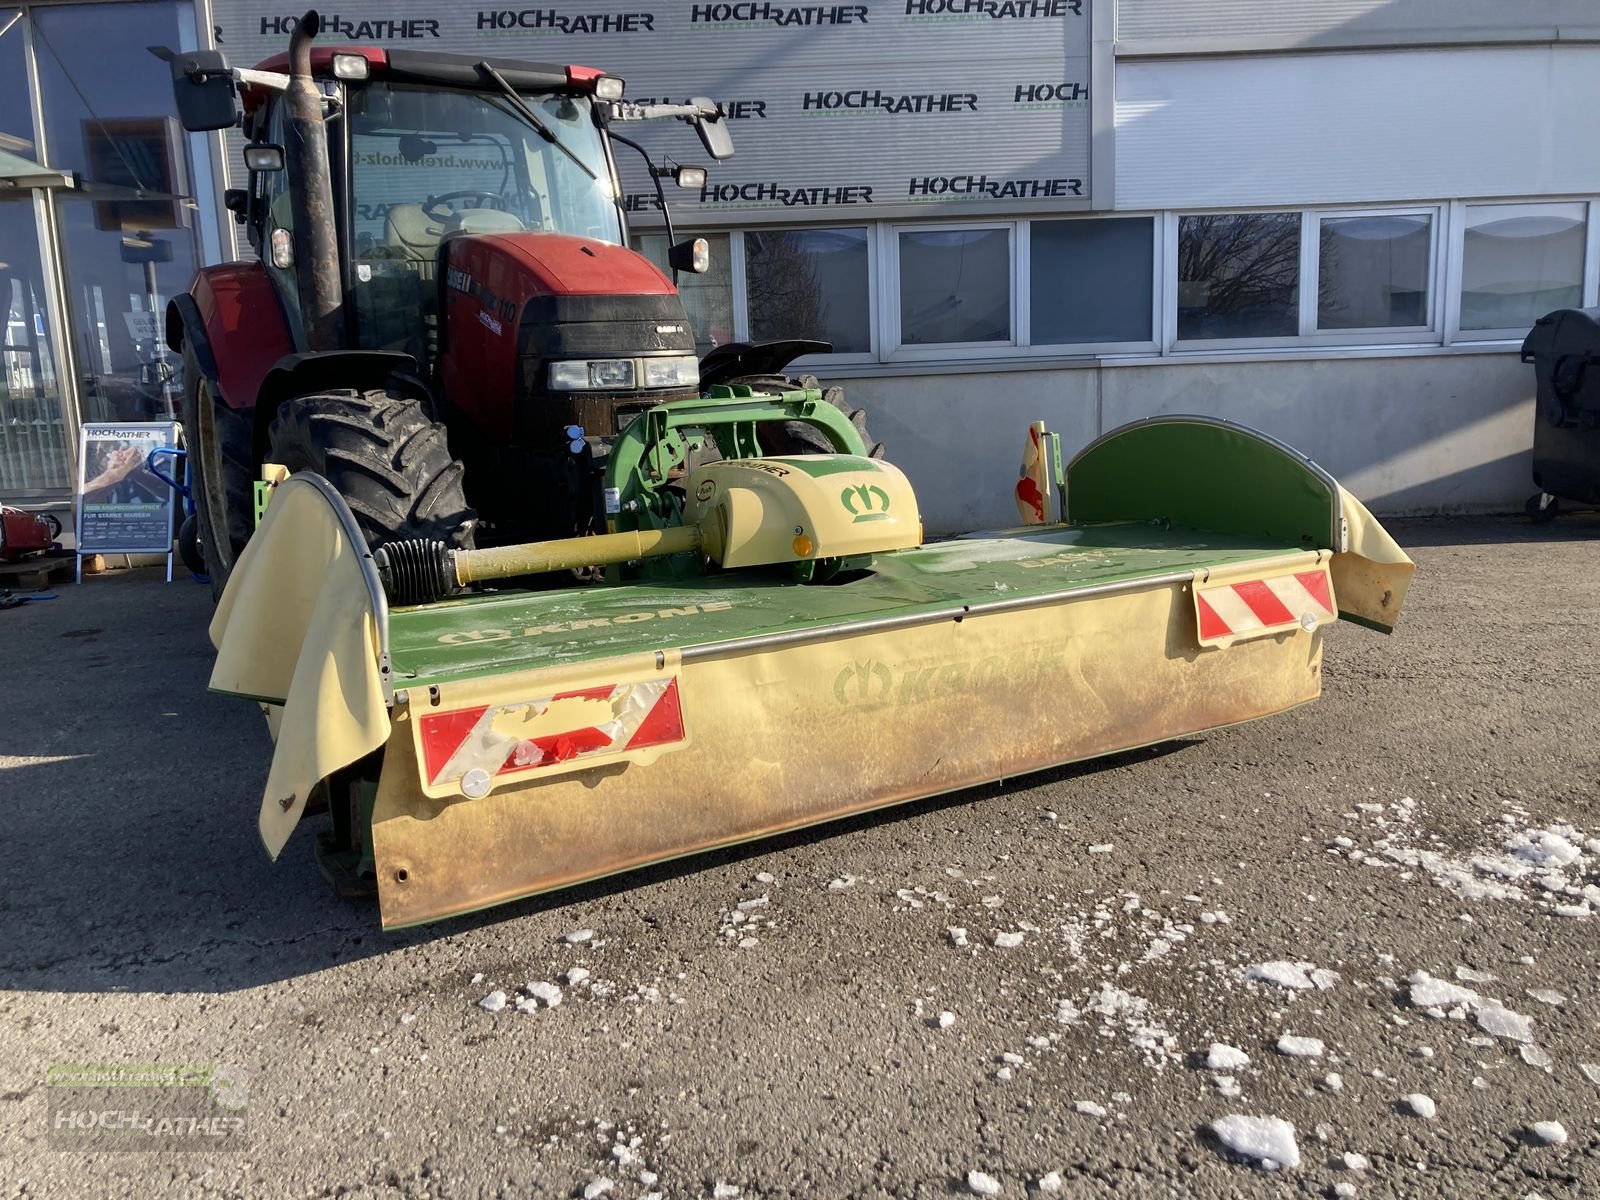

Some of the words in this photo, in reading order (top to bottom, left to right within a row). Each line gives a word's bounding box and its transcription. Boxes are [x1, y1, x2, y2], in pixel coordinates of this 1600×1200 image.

[477, 9, 655, 34] HOCHRATHER
[691, 2, 869, 26] HOCHRATHER
[905, 0, 1083, 19] HOCHRATHER
[260, 15, 440, 39] HOHRATHER
[802, 90, 978, 113] HOCHRATHER
[700, 183, 873, 206] HOCHRATHER
[909, 175, 1082, 199] HOCHRATHER
[88, 430, 150, 438] HOCHRATHER
[524, 601, 732, 637] KRONE
